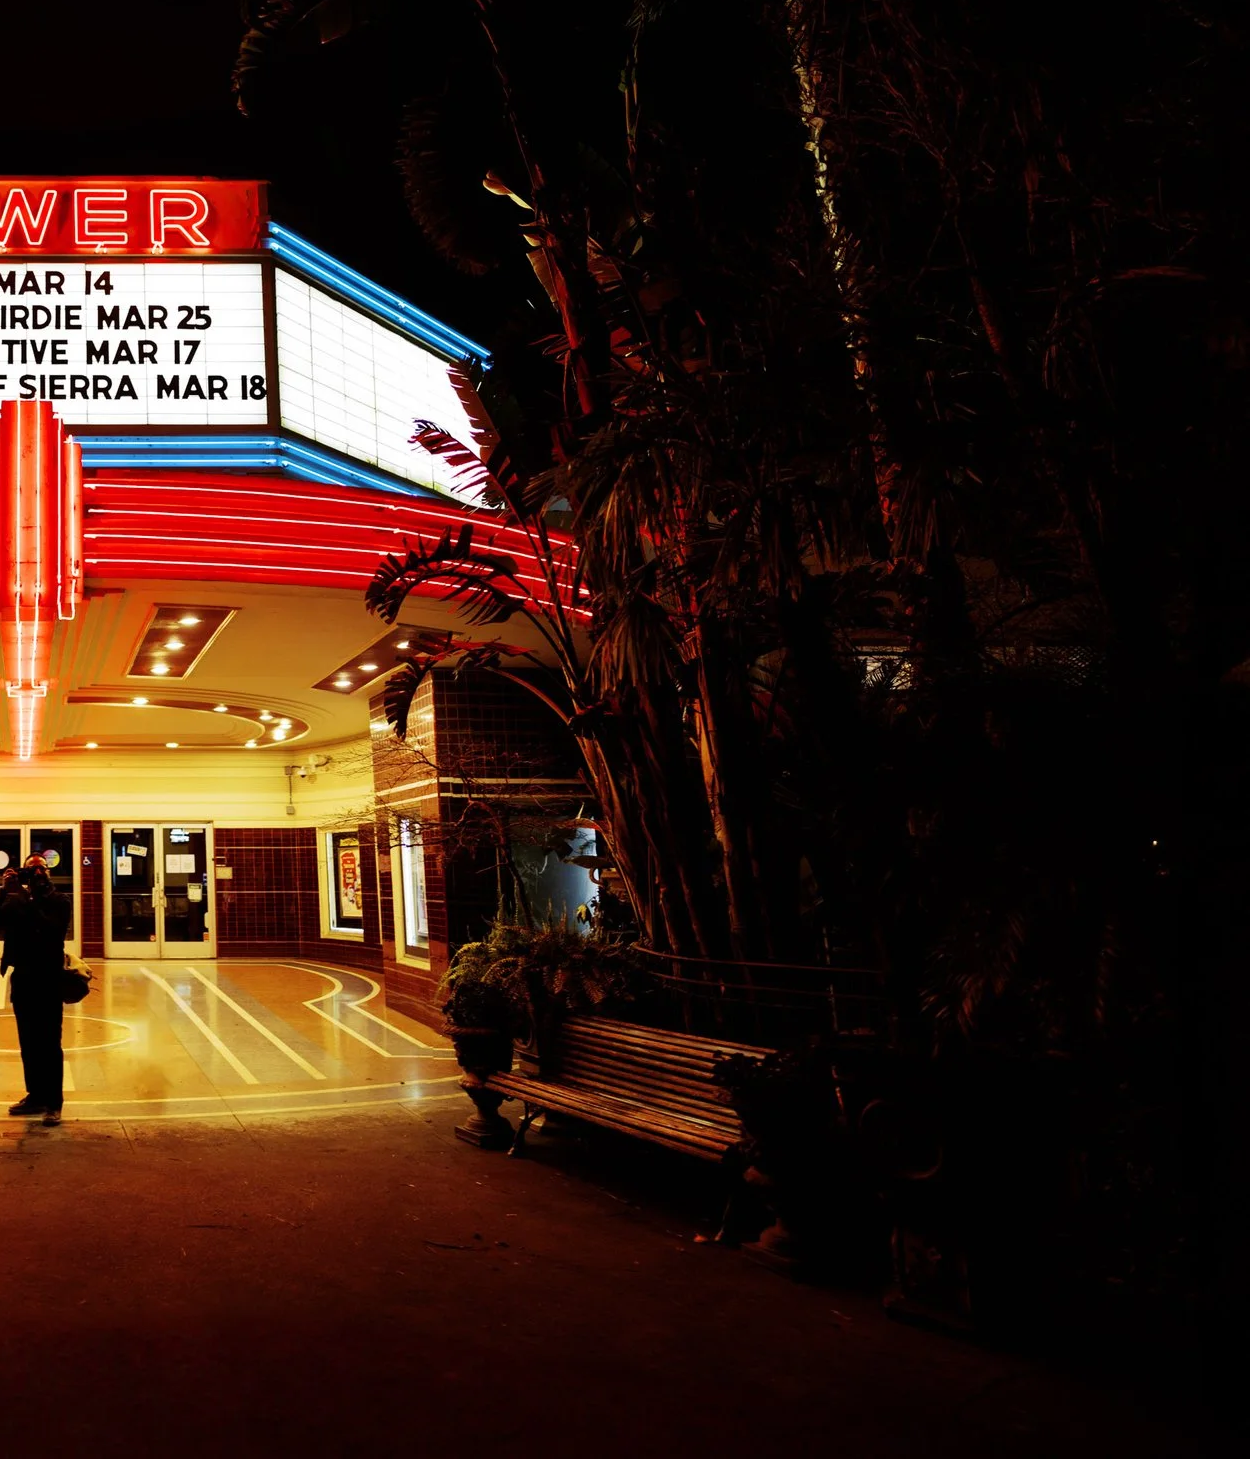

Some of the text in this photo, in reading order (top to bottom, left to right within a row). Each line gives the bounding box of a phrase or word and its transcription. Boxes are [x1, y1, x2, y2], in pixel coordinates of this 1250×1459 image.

[84, 270, 114, 296] 14
[97, 304, 168, 330] MAR
[176, 304, 212, 330] 25
[85, 339, 158, 365] MAR
[174, 339, 201, 365] 17
[19, 374, 139, 400] SIERRA
[156, 374, 228, 400] MAR
[241, 374, 267, 400] 18
